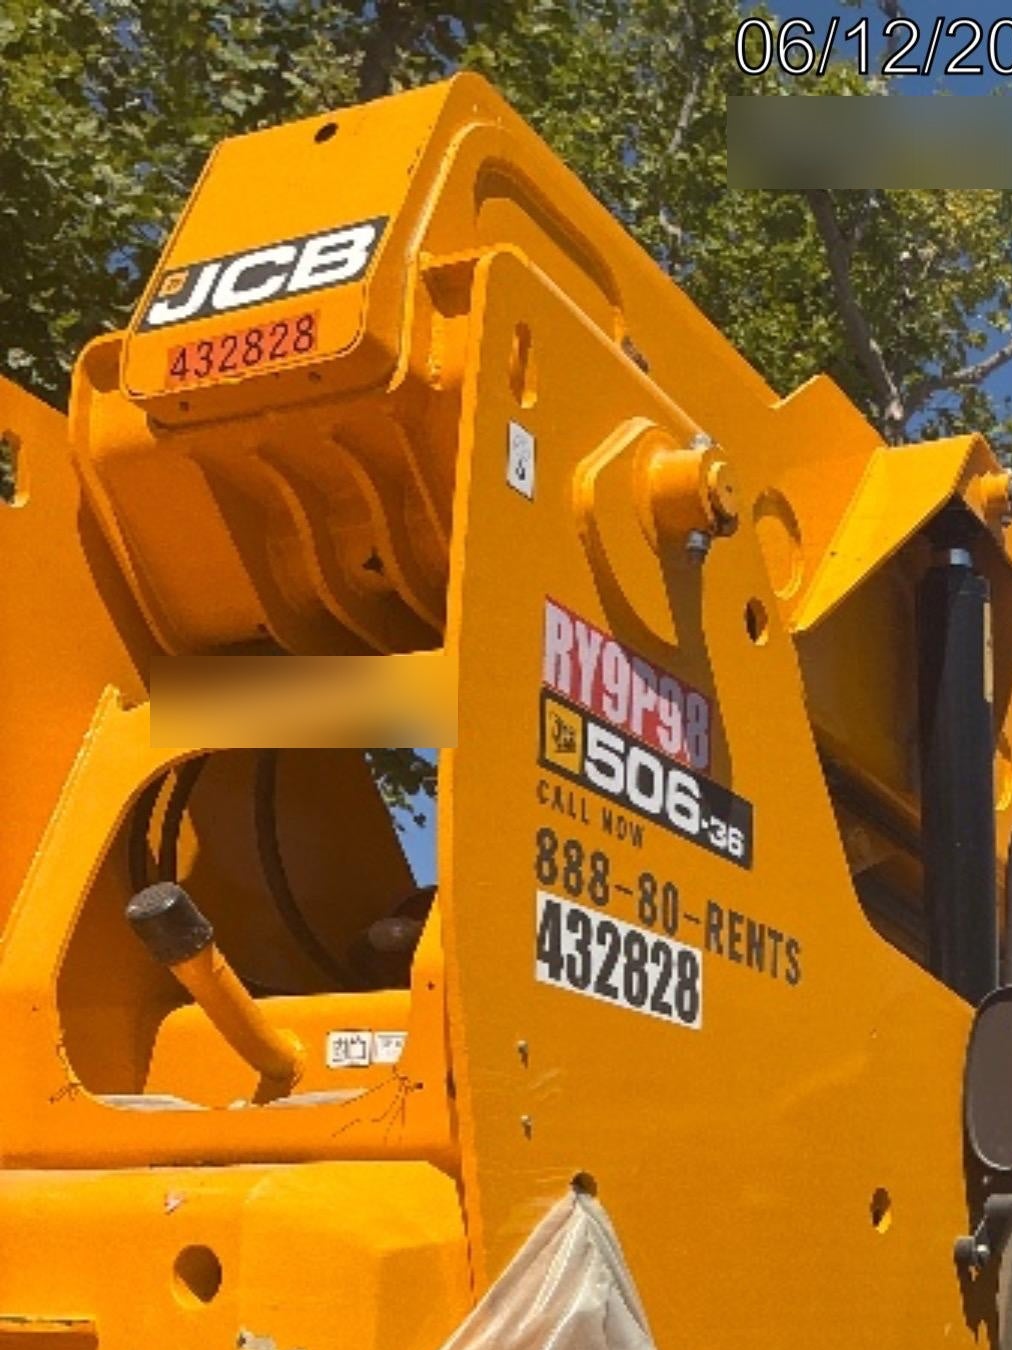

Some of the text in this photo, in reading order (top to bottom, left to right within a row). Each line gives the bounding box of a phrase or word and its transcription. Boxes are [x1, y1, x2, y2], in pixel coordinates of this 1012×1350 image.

[147, 224, 376, 325] JCB
[170, 312, 316, 381] 432828
[543, 599, 709, 769] RY9P98
[536, 779, 645, 849] CALL NOW
[535, 827, 802, 986] 888-80-RENTS
[537, 898, 701, 1024] 432828
